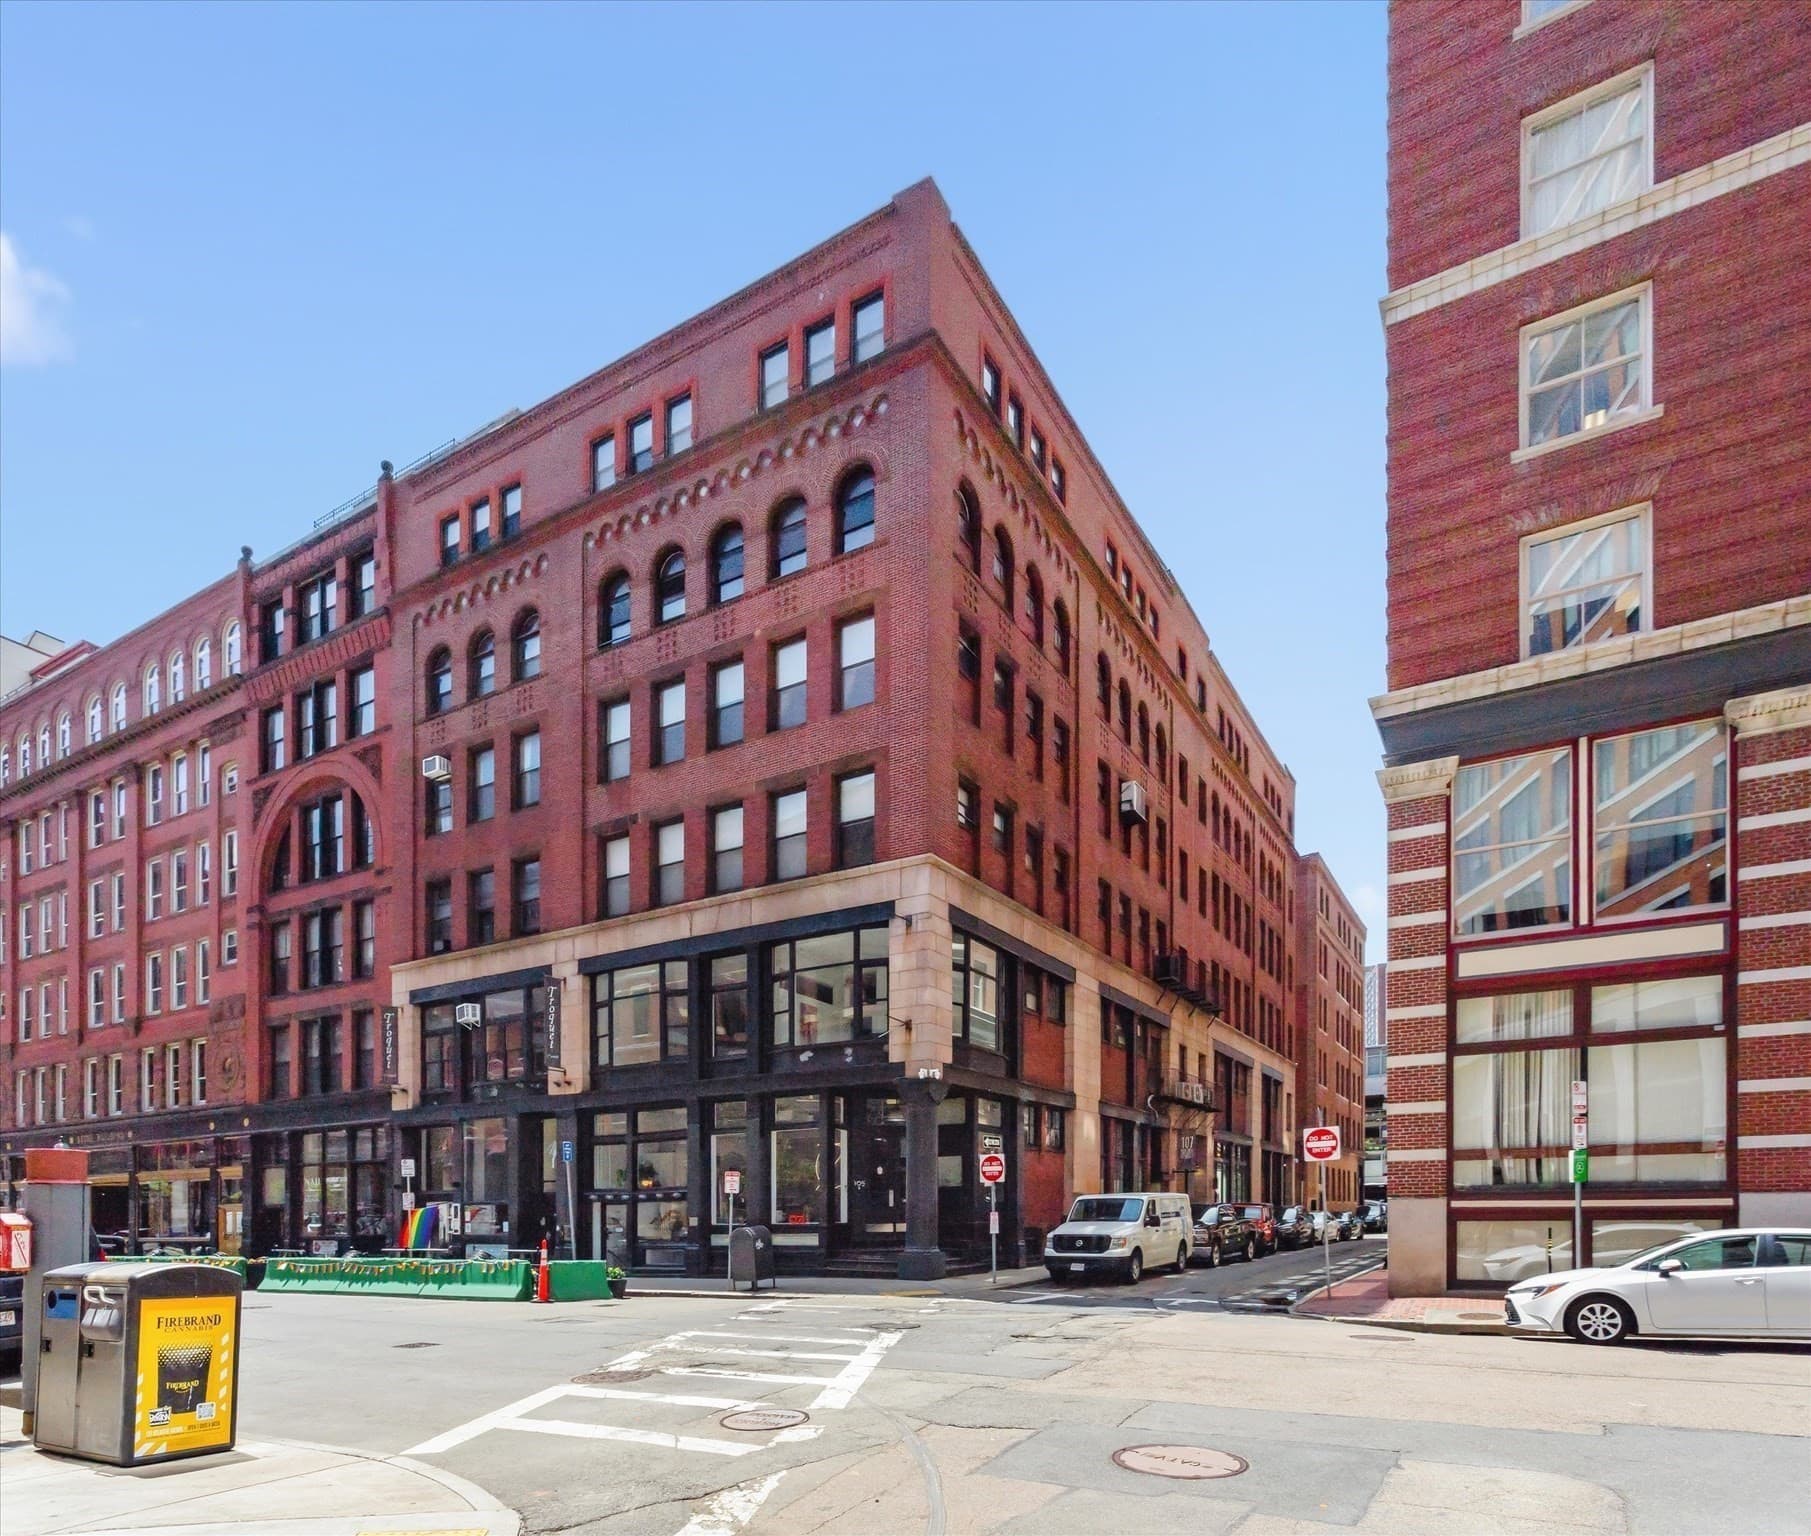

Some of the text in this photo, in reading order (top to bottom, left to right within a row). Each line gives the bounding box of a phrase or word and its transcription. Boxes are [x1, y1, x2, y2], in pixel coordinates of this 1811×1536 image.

[548, 985, 558, 1049] Troquet
[383, 1012, 395, 1070] Troquet
[1181, 1135, 1194, 1149] 107
[157, 1314, 222, 1329] FIREBRAND
[164, 1325, 214, 1333] CANNABIS
[166, 1379, 200, 1390] FIREBRAND
